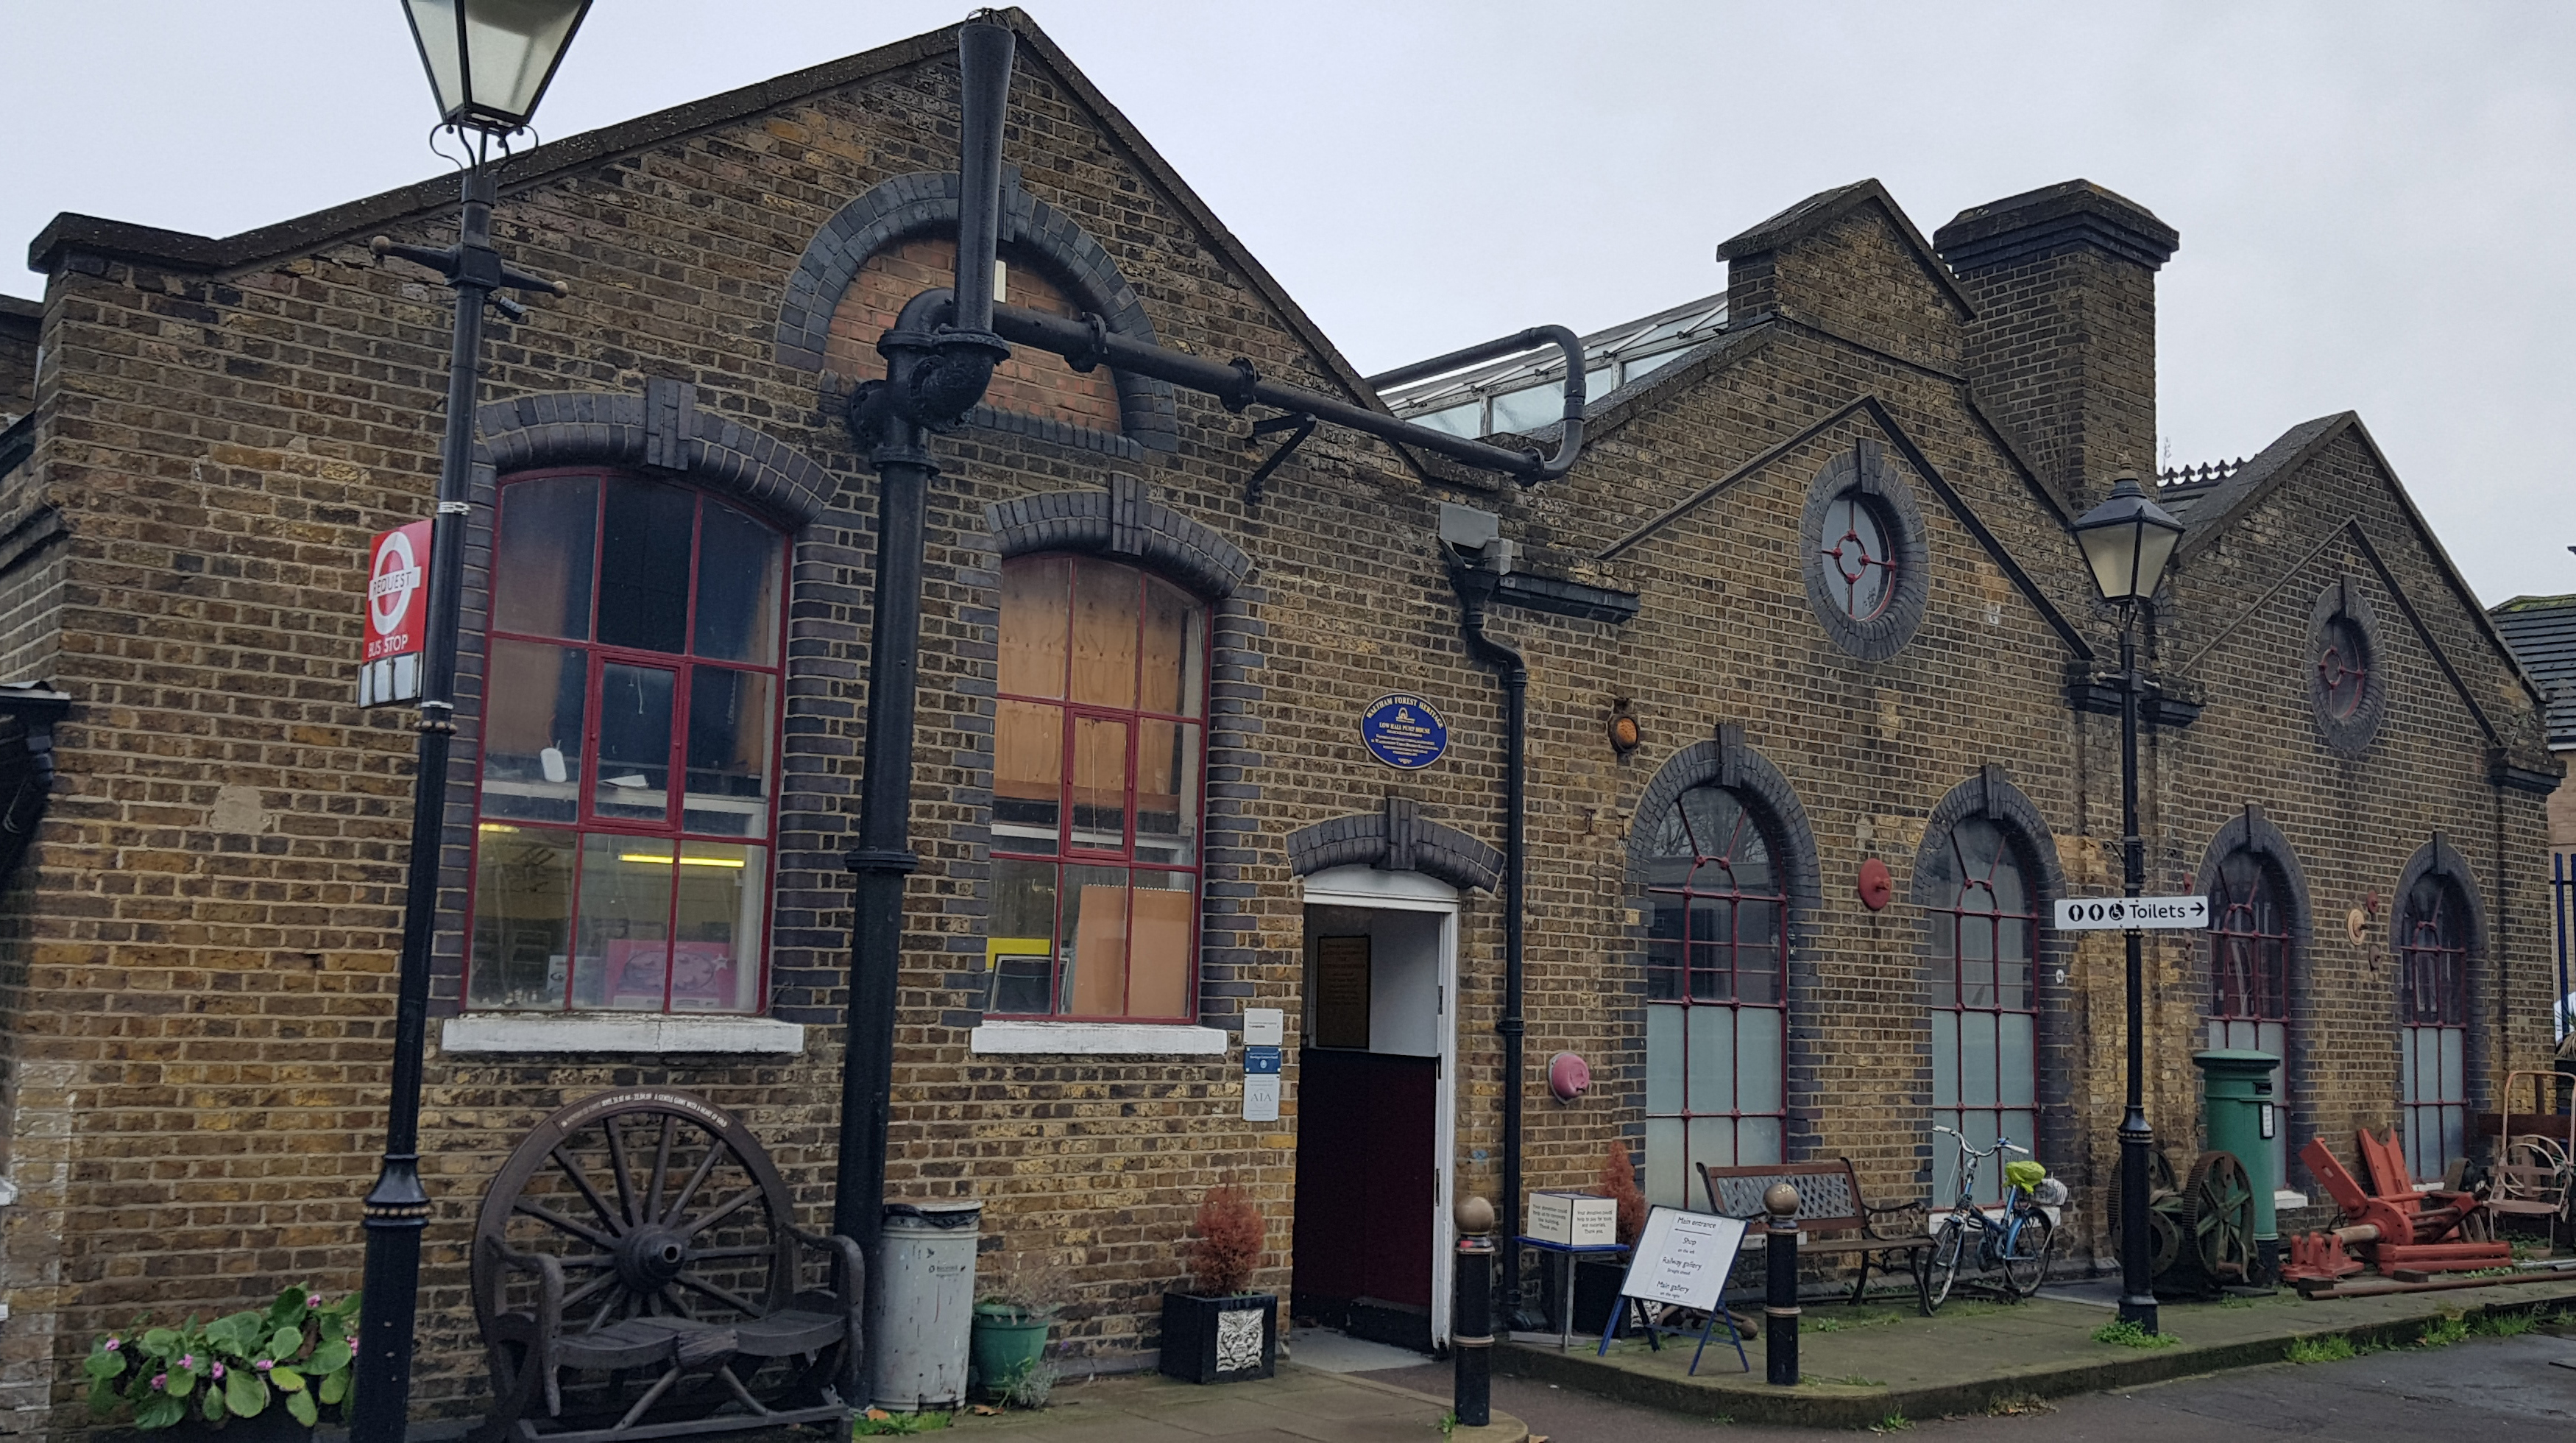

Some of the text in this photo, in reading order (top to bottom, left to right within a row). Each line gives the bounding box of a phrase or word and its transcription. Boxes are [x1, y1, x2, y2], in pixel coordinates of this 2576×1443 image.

[372, 572, 412, 595] REQUEST
[368, 635, 408, 657] BUS STOP
[1367, 697, 1444, 730] WALTHAM FOREST HERITAGE
[2129, 904, 2185, 919] Toilets
[1251, 1093, 1272, 1101] AIA
[1683, 1238, 1696, 1246] Shop
[1663, 1257, 1702, 1271] Railway gallery
[1657, 1281, 1689, 1294] Main gallery
